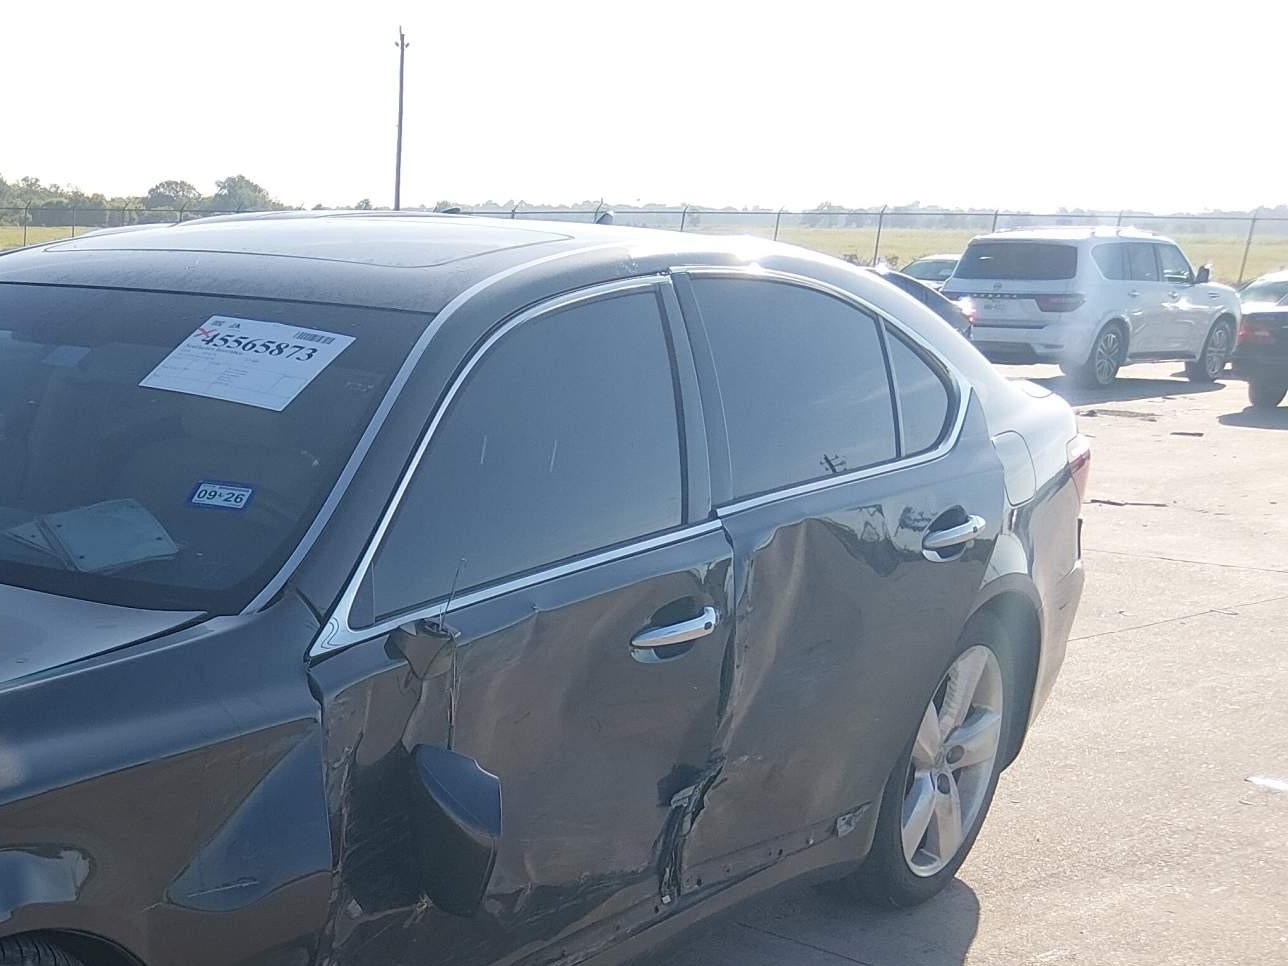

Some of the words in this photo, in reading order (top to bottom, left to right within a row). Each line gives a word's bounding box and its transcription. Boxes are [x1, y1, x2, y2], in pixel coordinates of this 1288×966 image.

[201, 332, 318, 362] 45565873
[197, 489, 217, 500] 09
[223, 492, 245, 504] 26
